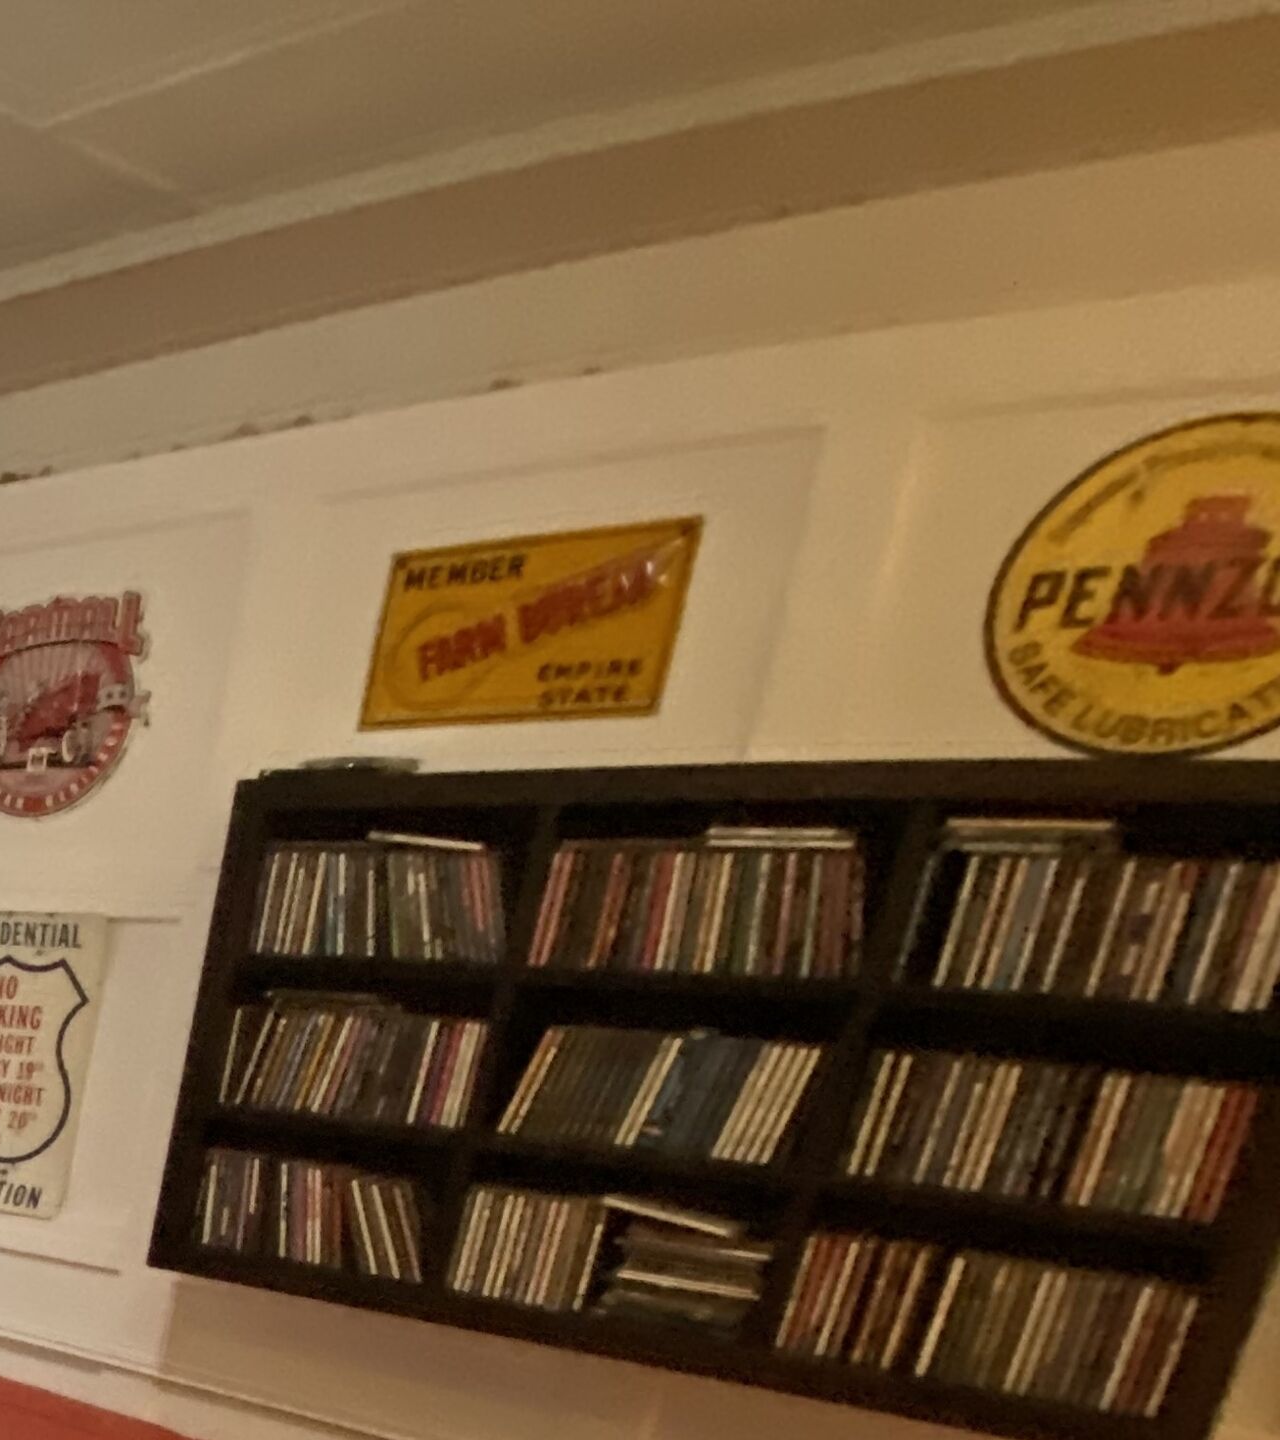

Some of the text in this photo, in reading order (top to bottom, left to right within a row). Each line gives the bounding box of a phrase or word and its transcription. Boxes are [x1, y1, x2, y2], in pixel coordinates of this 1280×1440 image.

[404, 553, 527, 592] MEMBER
[416, 612, 507, 682] FARM
[537, 658, 641, 682] EMPIRE
[539, 683, 630, 707] STATE
